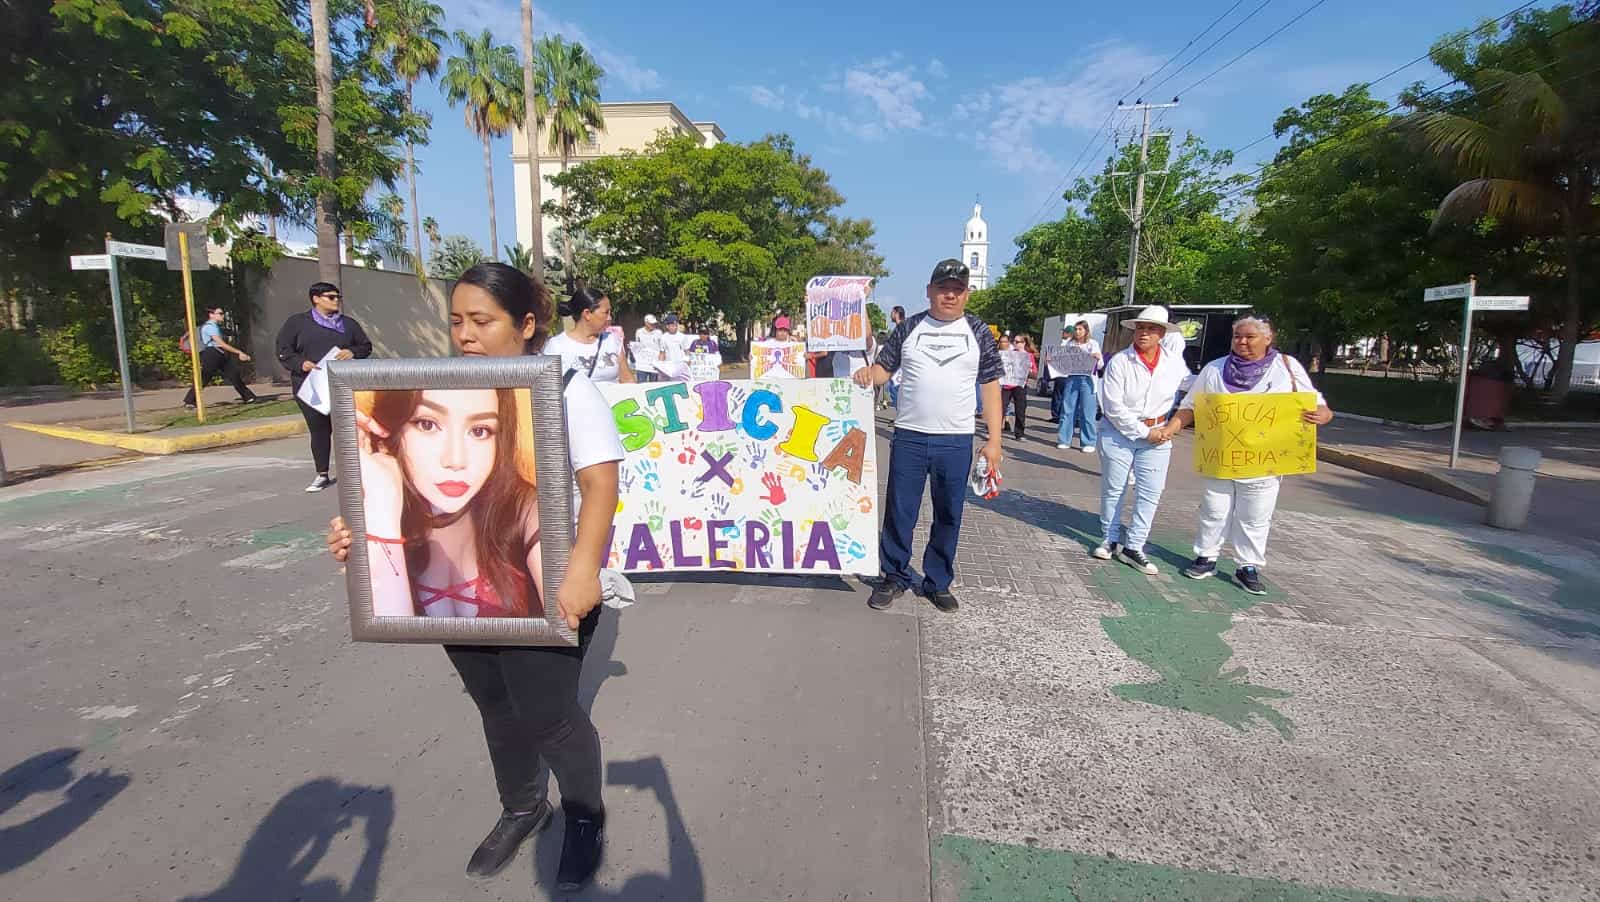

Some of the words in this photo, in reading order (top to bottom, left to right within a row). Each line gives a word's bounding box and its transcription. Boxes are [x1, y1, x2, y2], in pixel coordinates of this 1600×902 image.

[611, 381, 867, 486] STICIA
[1226, 427, 1247, 449] X
[696, 449, 735, 488] X
[1201, 447, 1278, 467] VALERIA
